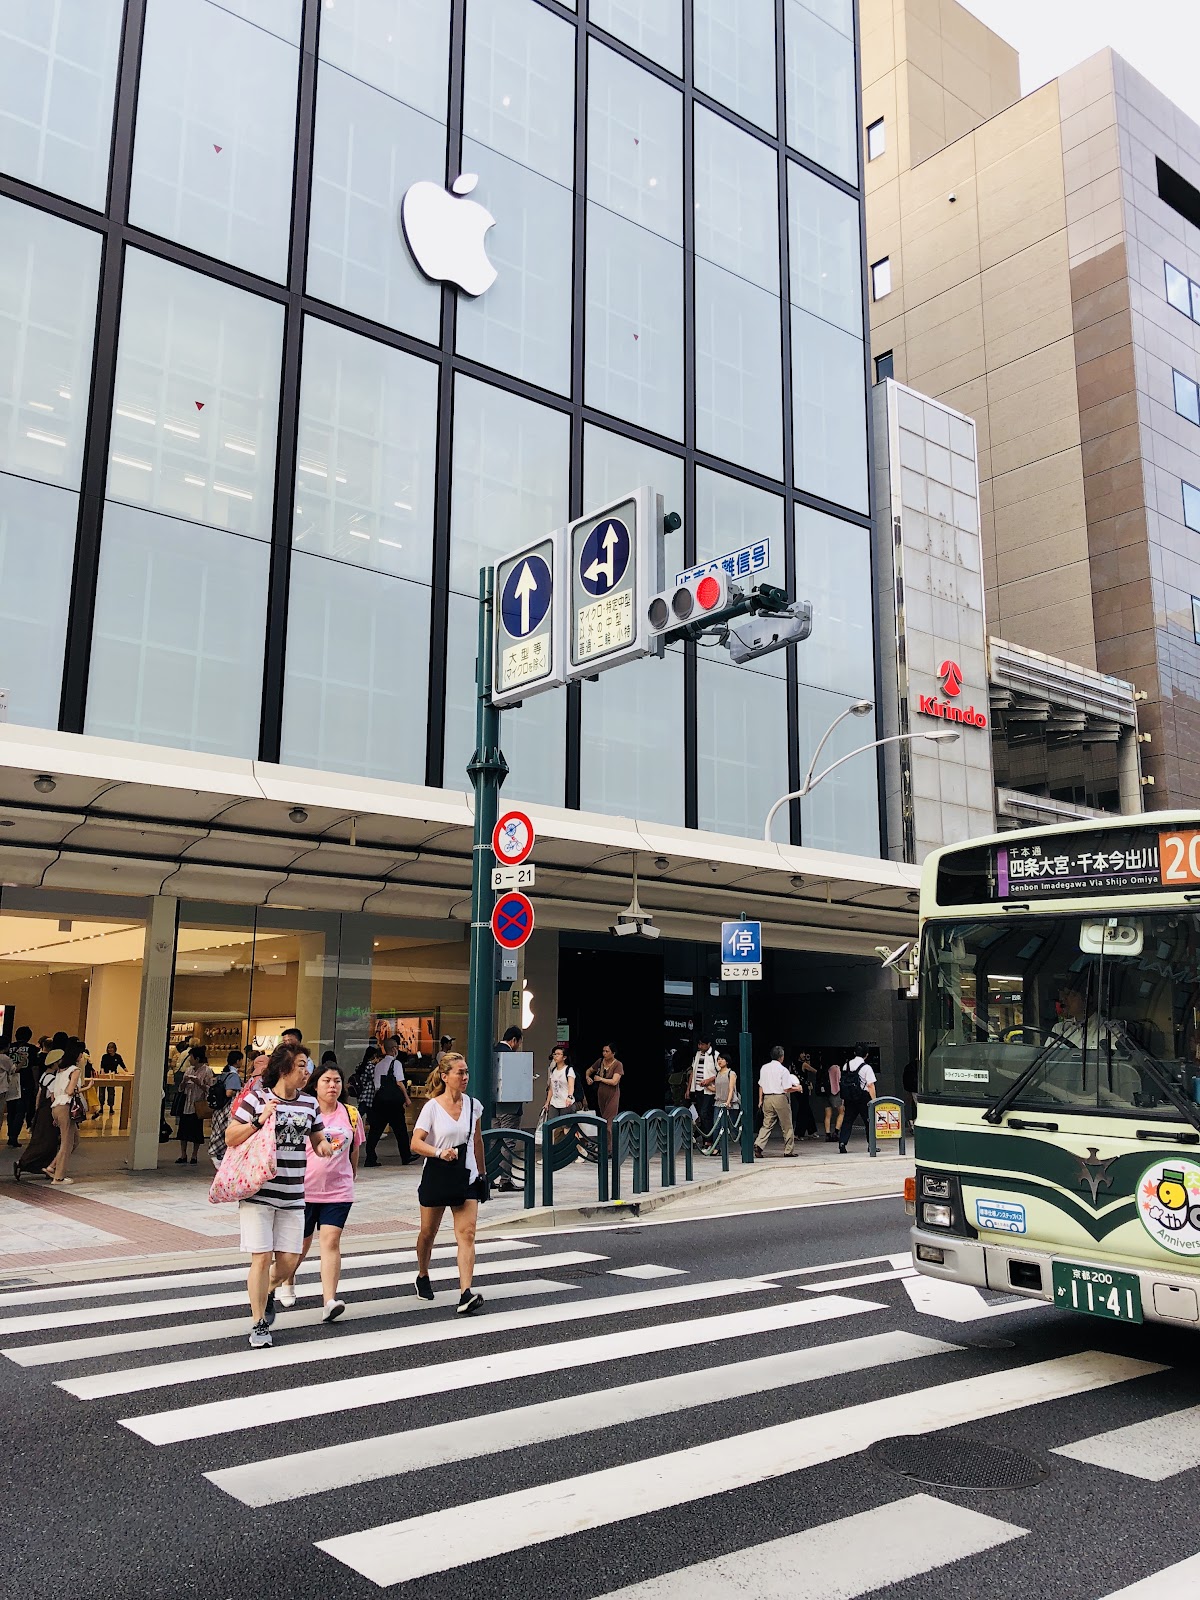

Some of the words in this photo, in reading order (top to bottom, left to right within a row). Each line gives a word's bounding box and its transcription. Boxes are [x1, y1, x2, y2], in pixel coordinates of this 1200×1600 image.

[919, 695, 987, 727] Kirindo
[1010, 845, 1042, 858] 千本通
[1010, 847, 1159, 878] 四条大宮・千本今出川
[1010, 883, 1039, 892] Senbon
[1041, 880, 1087, 890] Imadegawa
[1105, 876, 1128, 887] Shijo
[1130, 874, 1159, 886] Omiya
[728, 928, 755, 957] 停
[723, 967, 760, 977] ここから
[1057, 1285, 1067, 1297] か
[1071, 1279, 1134, 1319] 11-41
